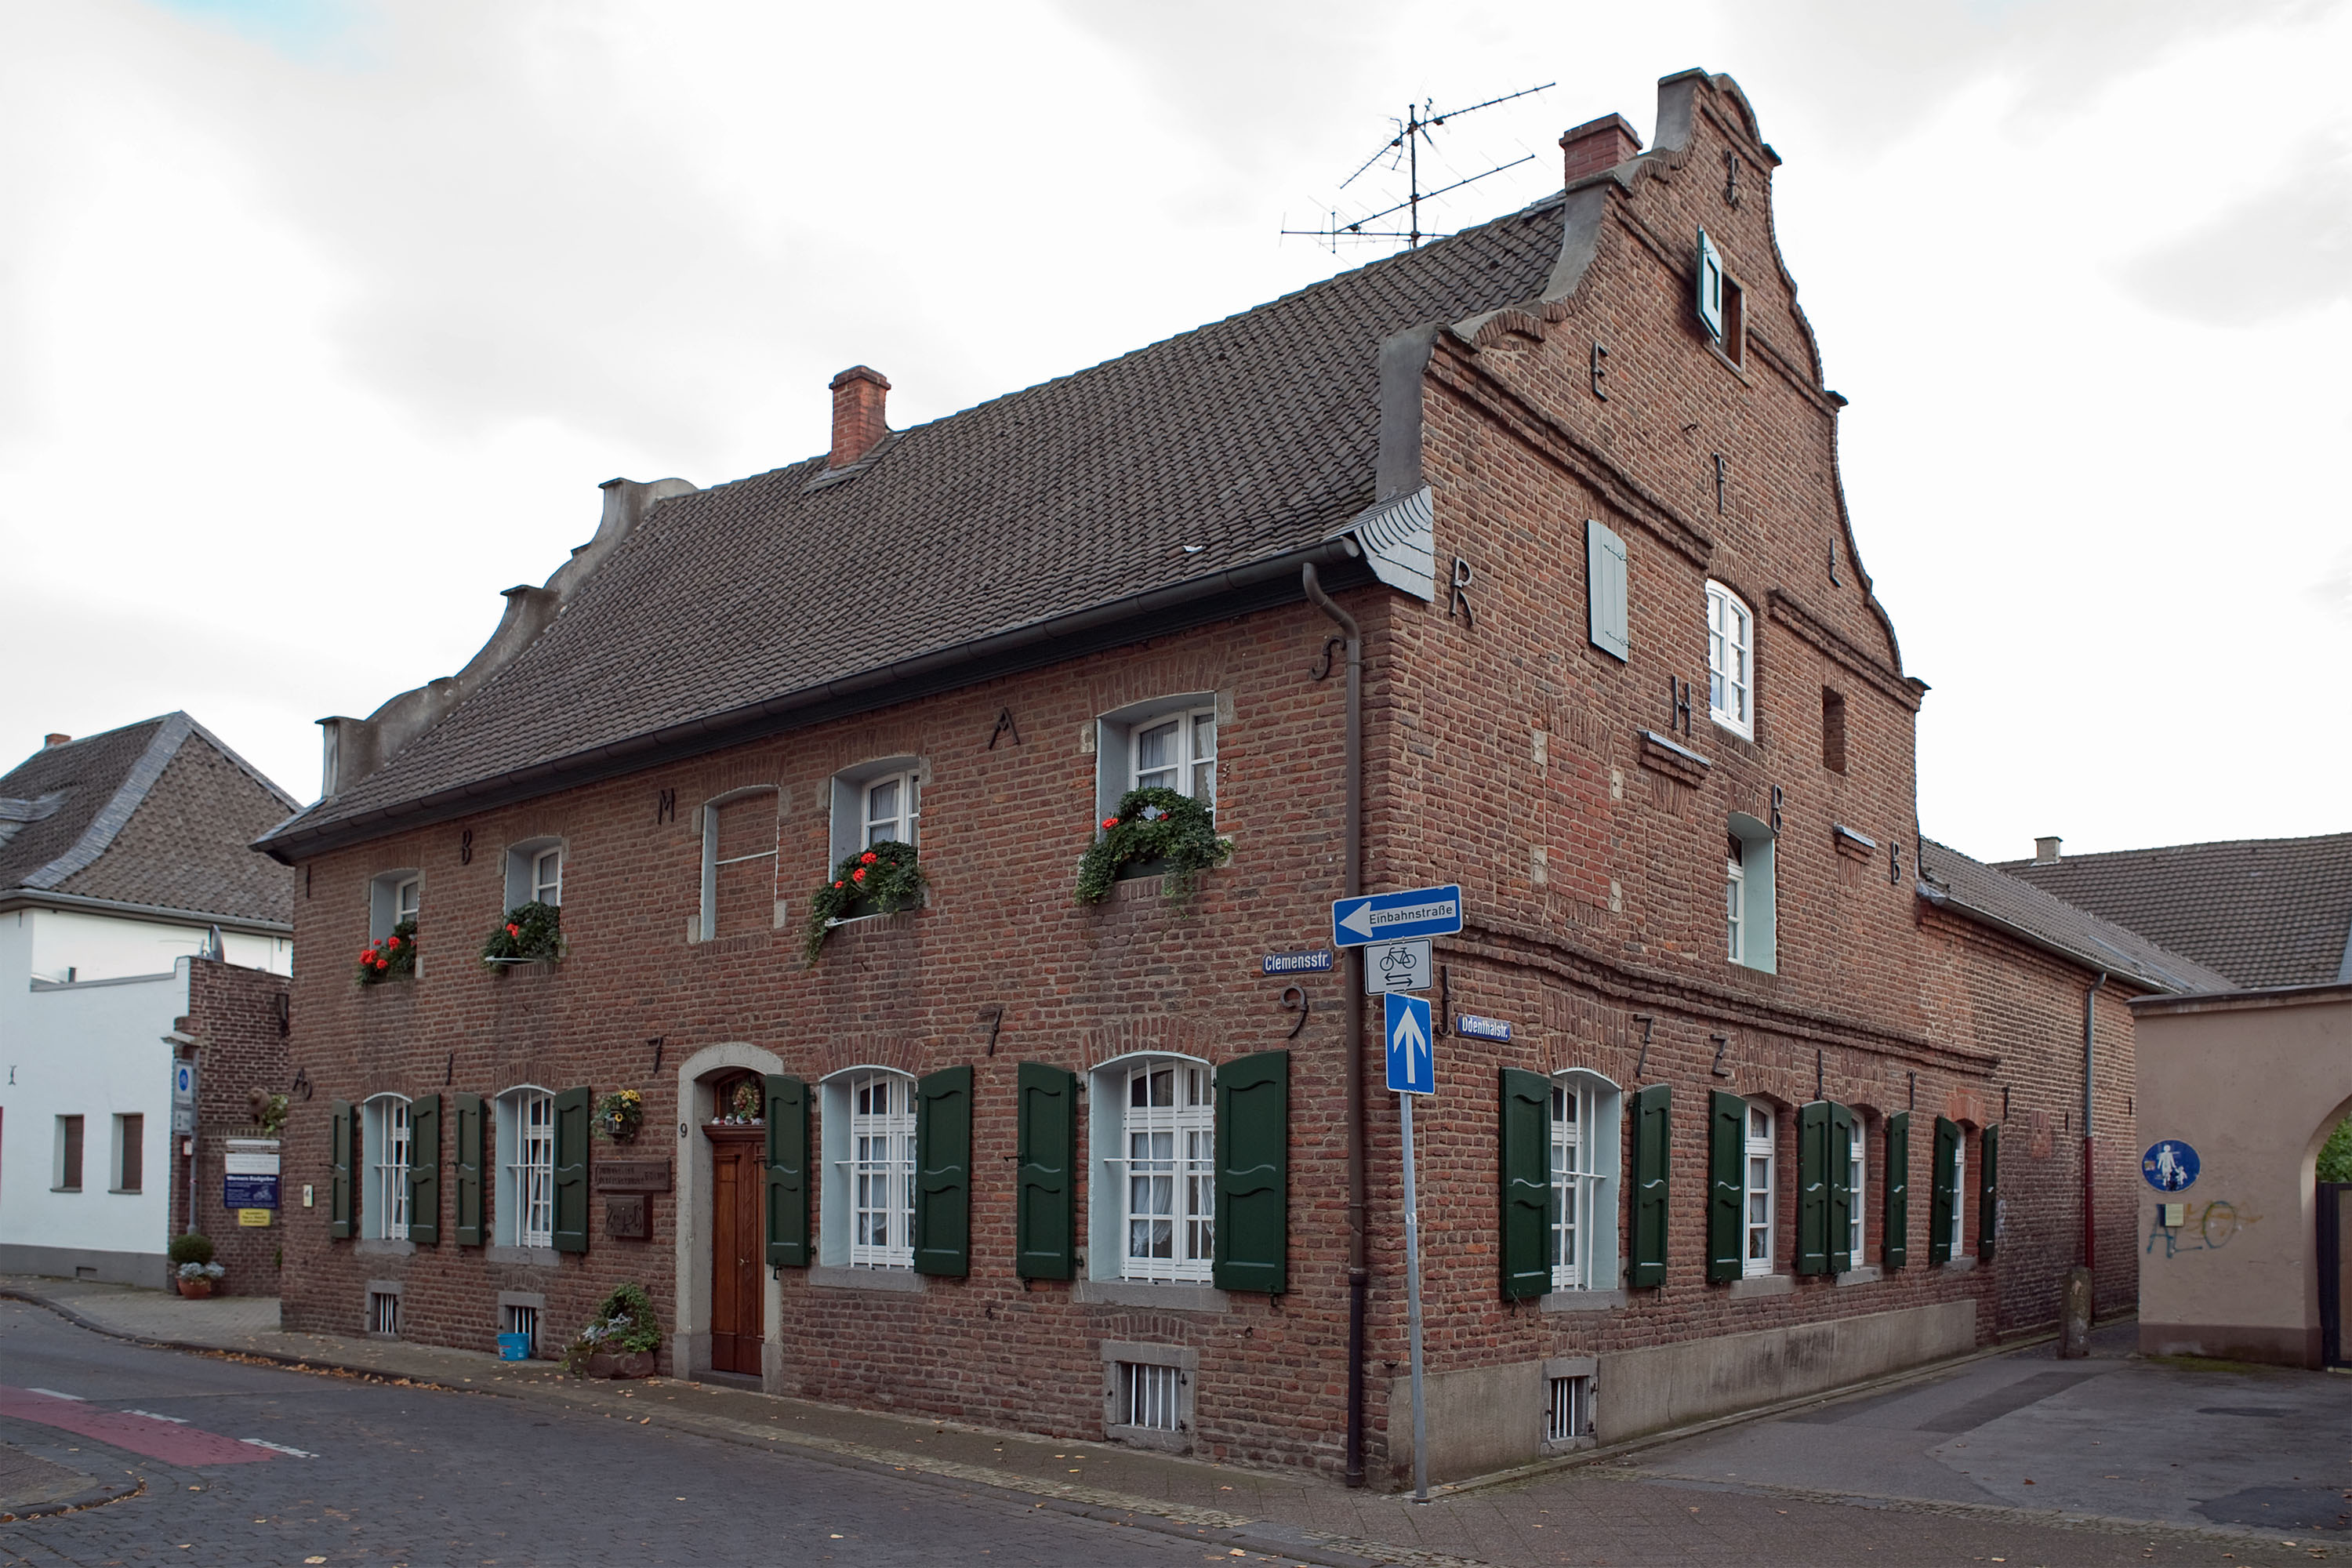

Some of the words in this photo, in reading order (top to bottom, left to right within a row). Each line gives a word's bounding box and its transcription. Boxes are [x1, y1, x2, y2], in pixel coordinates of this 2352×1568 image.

[1450, 556, 1474, 627] R
[1671, 675, 1691, 737] H
[1771, 784, 1784, 834] B
[988, 706, 1021, 750] A
[1369, 905, 1453, 924] Einbahnstraße
[1265, 951, 1330, 971] Clemensstr.
[1461, 1016, 1508, 1038] Odenthalstr.
[680, 1122, 688, 1138] 9
